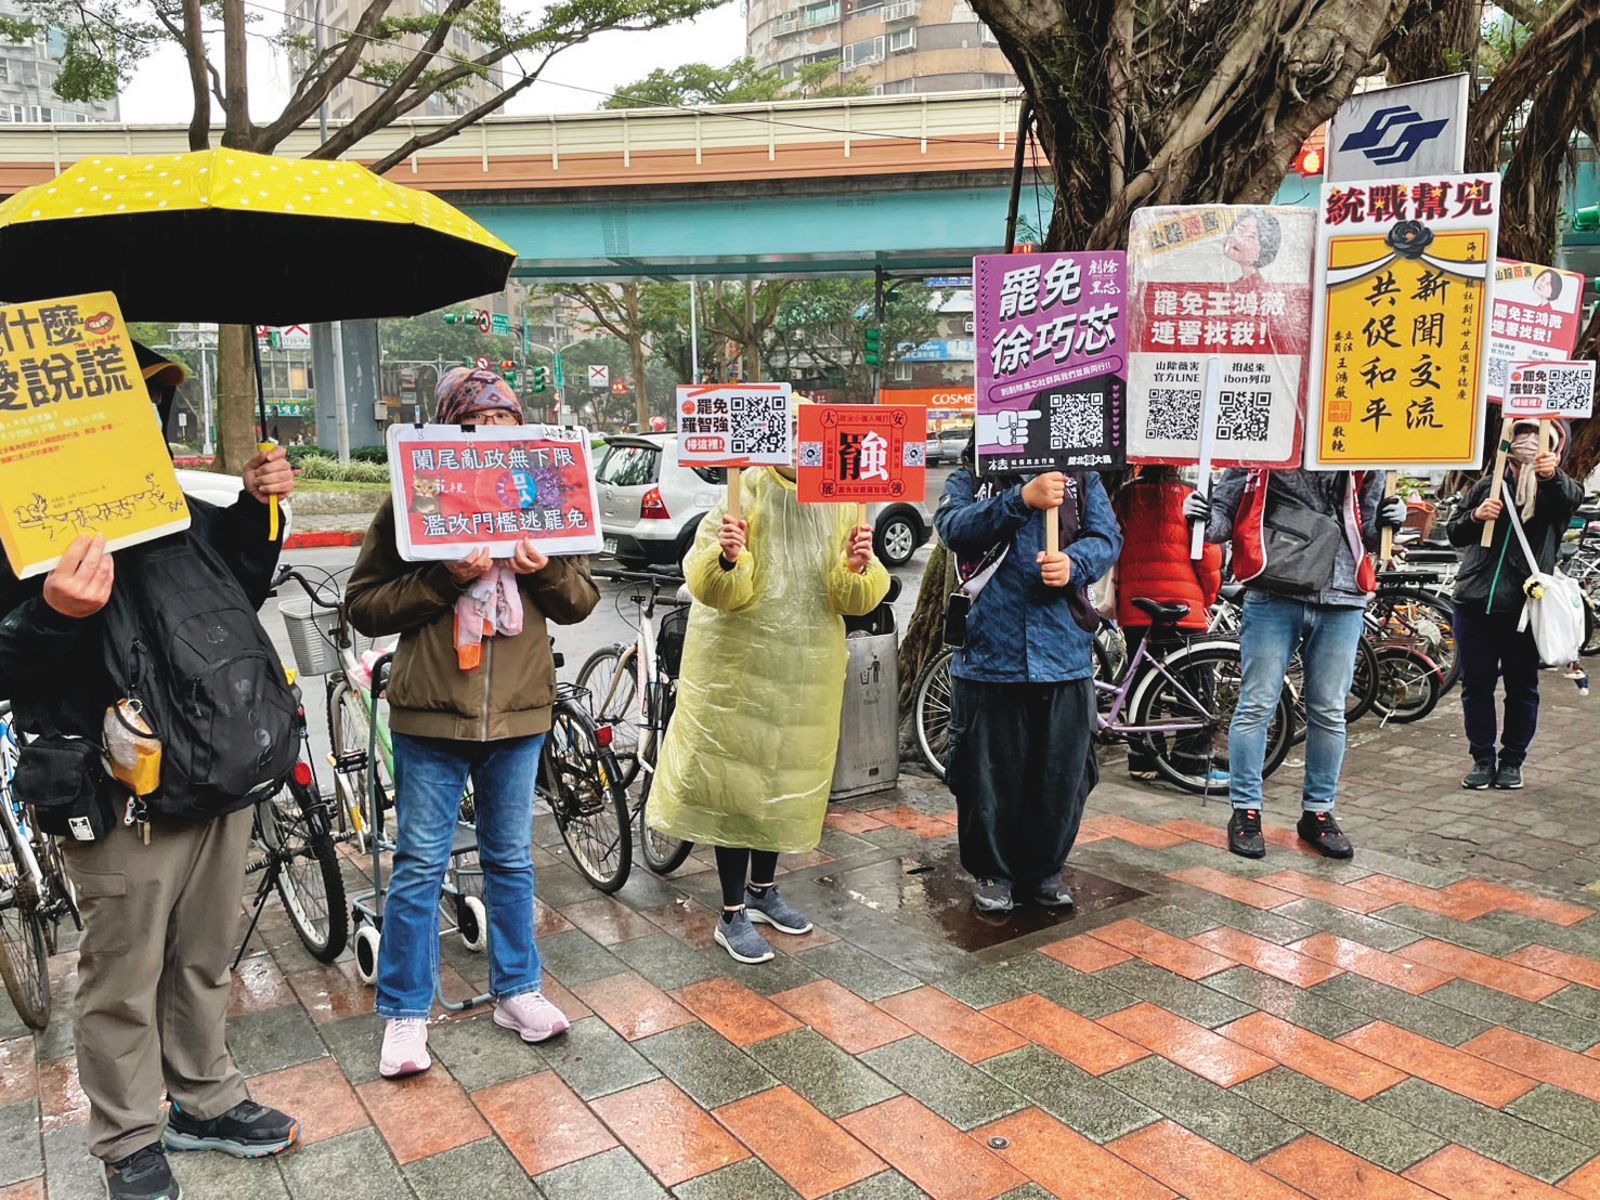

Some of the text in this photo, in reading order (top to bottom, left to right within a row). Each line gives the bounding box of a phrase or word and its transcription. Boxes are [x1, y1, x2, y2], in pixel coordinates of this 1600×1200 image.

[1325, 179, 1493, 225] 統戰幫兇
[1000, 258, 1081, 319] 罷免
[1154, 291, 1285, 317] 罷免王鴻薇
[1151, 321, 1268, 346] 連署找我!
[1454, 242, 1477, 400] 海報社創刊廿五週年誌慶
[991, 303, 1118, 378] 徐巧芯
[1360, 271, 1403, 432] 共促和平
[1405, 270, 1450, 431] 新聞交流
[1153, 372, 1201, 383] 官方LINE
[1224, 374, 1272, 384] ibon列印
[697, 398, 729, 415] 罷免
[682, 417, 729, 433] 羅智強
[411, 447, 576, 471] 闌尾亂政無下限
[422, 507, 588, 537] 濫改門檻逃罷免
